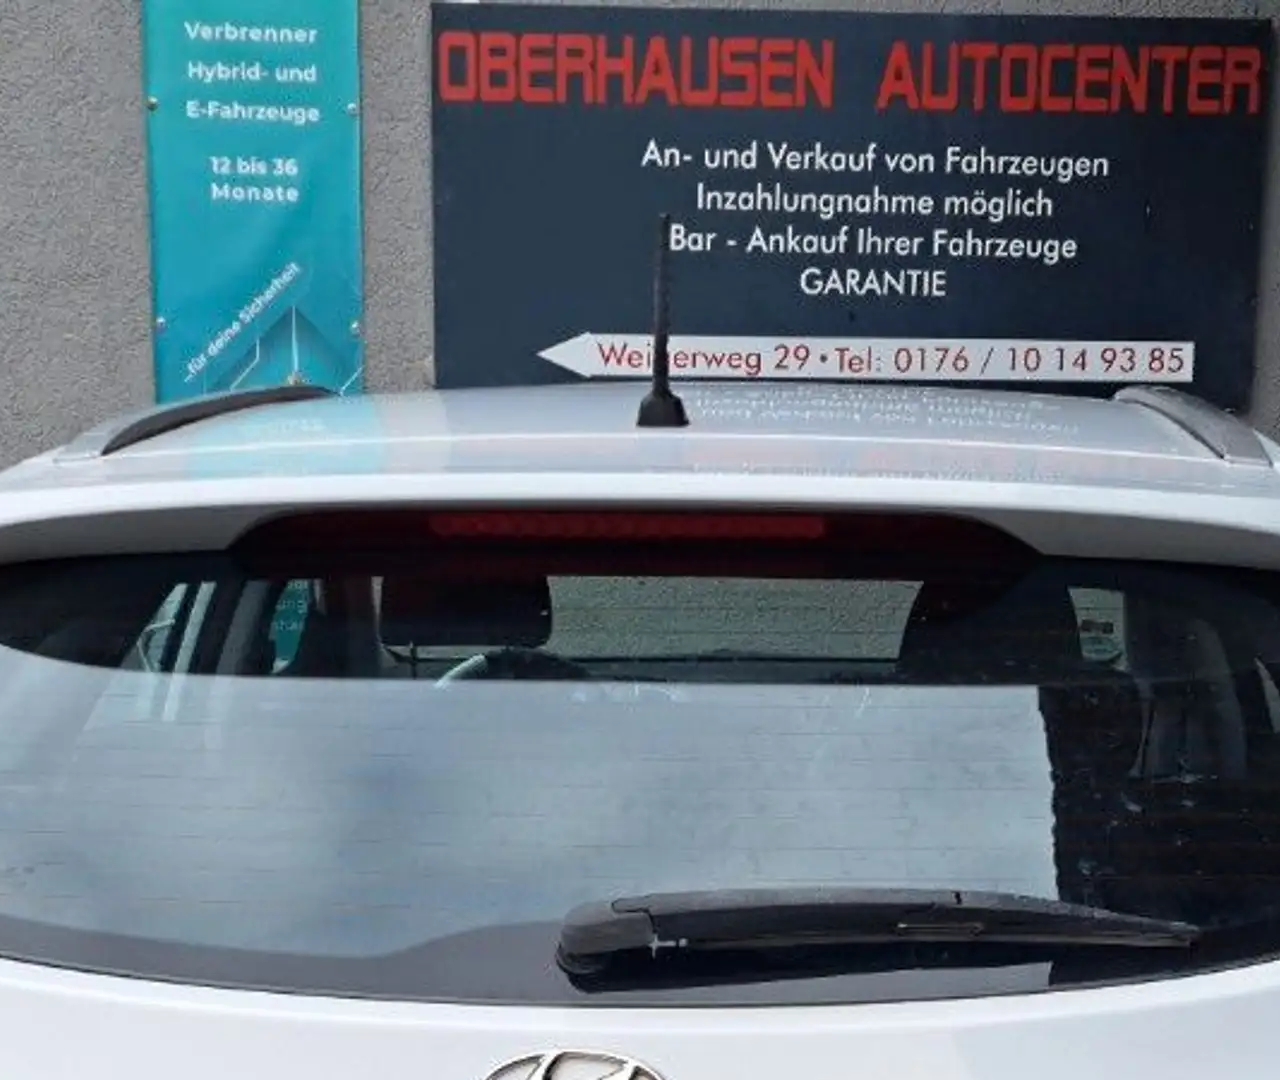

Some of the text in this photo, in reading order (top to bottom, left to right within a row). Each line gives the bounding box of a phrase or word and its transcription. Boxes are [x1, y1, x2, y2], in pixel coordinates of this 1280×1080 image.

[184, 20, 318, 44] Verbrenner
[188, 61, 318, 83] Hybrid- und
[438, 31, 1262, 114] OBERHAUSEN AUTOCENTER
[186, 100, 320, 125] E-Fahrzeuge
[210, 156, 299, 175] 12 bis 36
[641, 139, 1109, 182] An- und Verkauf von Fahrzeugen
[210, 183, 299, 202] Monate
[697, 183, 1053, 221] Inzahlungnahme möglich
[669, 224, 718, 251] Bar
[746, 225, 850, 253] Ankauf
[858, 228, 924, 256] Ihrer
[932, 229, 1078, 265] Fahrzeuge
[800, 267, 946, 297] GARANTIE
[597, 341, 762, 375] Weierweg
[774, 344, 810, 370] 29
[835, 346, 882, 373] Tel:
[893, 346, 969, 374] 0176
[1007, 347, 1041, 373] 10
[1055, 347, 1088, 373] 14
[1100, 347, 1136, 374] 93
[1148, 347, 1184, 374] 85
